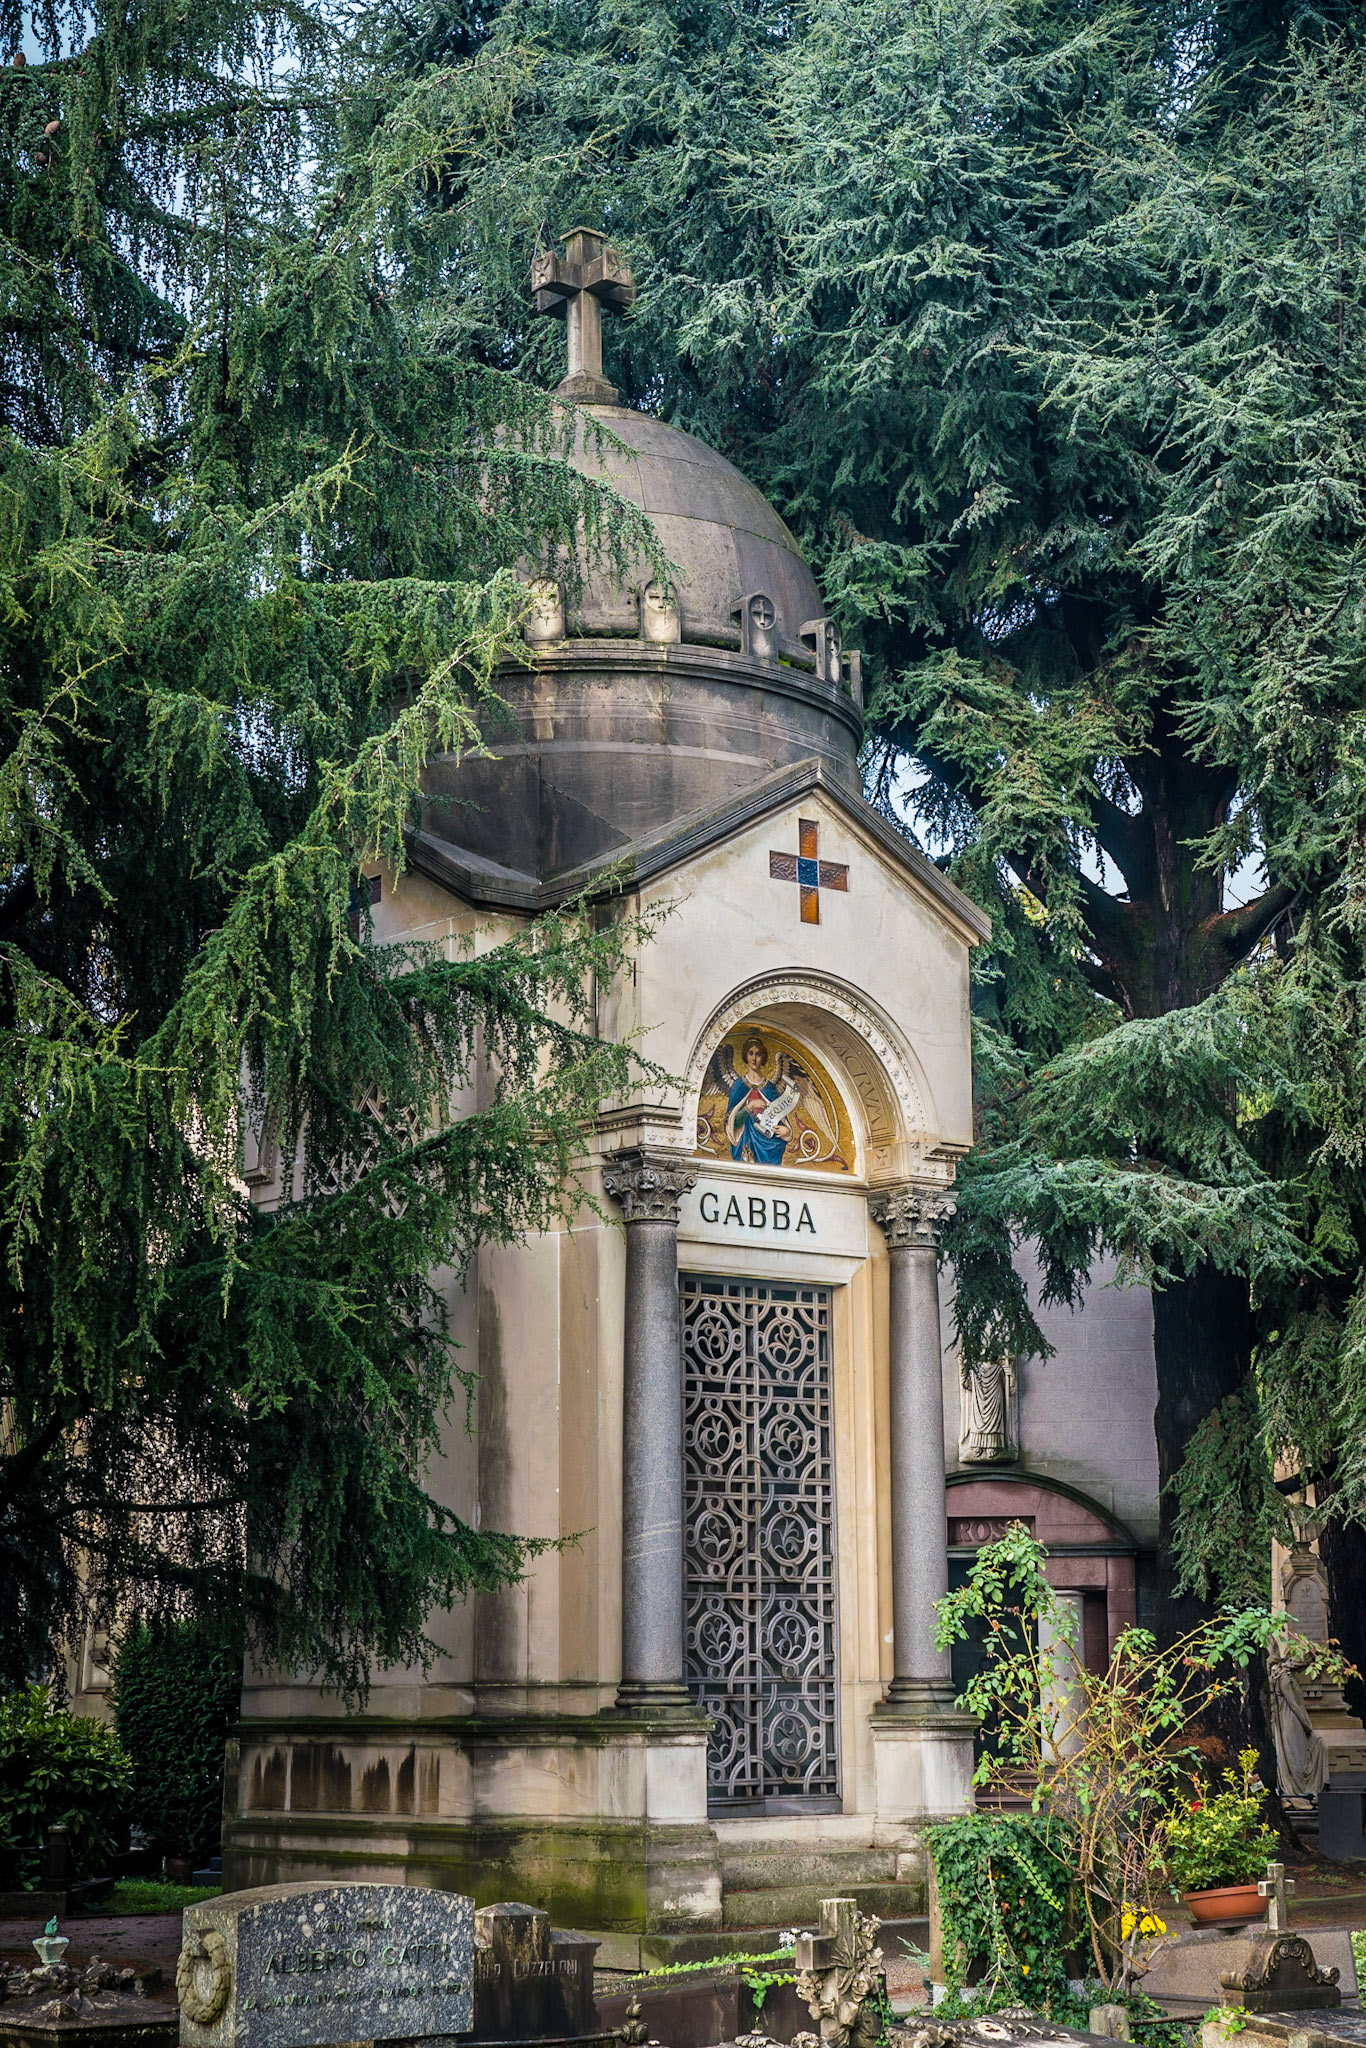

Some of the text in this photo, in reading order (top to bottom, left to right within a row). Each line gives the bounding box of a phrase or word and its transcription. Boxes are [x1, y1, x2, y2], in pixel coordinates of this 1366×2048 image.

[700, 1192, 817, 1233] GABBA
[957, 1520, 1018, 1543] ROS
[265, 1943, 450, 1975] ALBERTO GATTI
